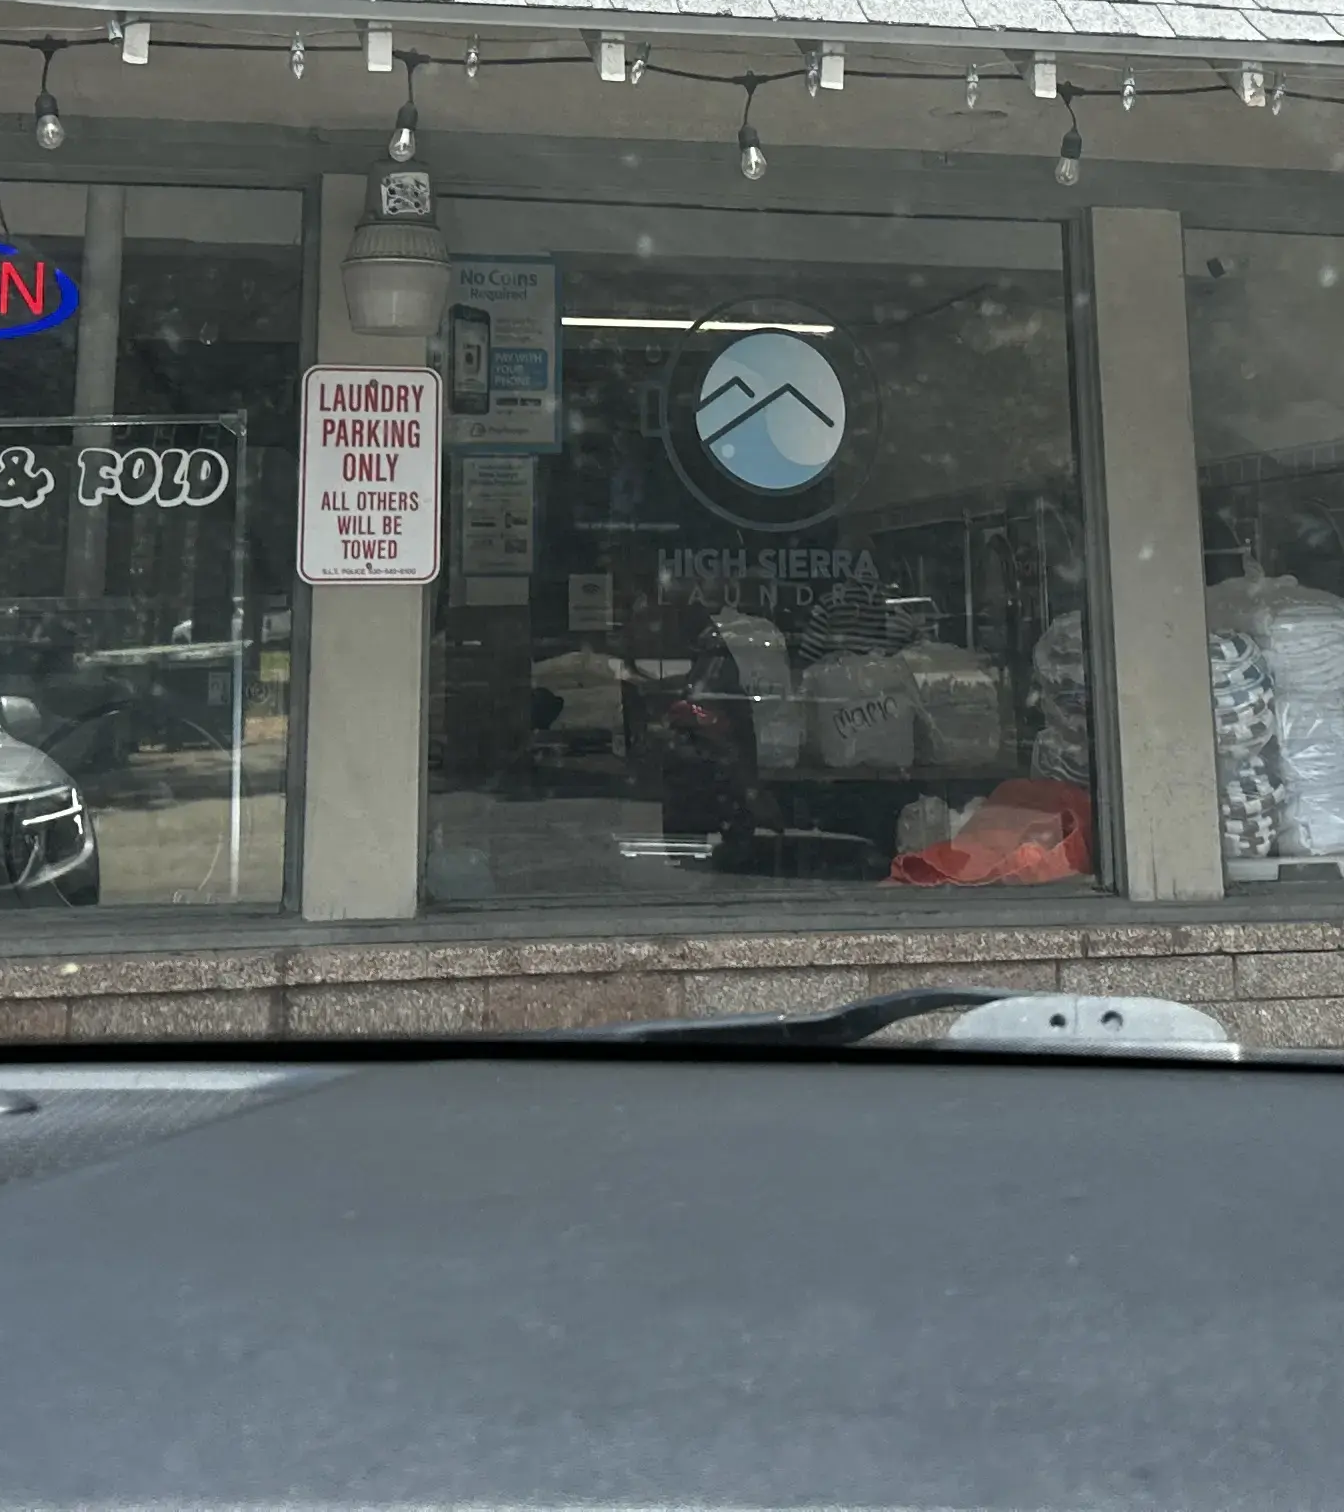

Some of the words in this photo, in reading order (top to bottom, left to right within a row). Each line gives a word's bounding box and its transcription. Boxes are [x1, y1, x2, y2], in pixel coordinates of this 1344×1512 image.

[460, 268, 485, 286] No
[488, 268, 538, 287] Coins
[319, 383, 425, 414] LAUNDRY
[321, 419, 421, 449] PARKING
[78, 446, 230, 508] FOLD
[342, 453, 400, 483] ONLY
[321, 492, 351, 512] ALL
[357, 491, 419, 512] OTHERS
[337, 515, 376, 536] WILL
[382, 515, 402, 536] BE
[341, 539, 398, 561] TOWED
[658, 549, 746, 580] HIGH
[757, 549, 880, 580] SIERRA
[658, 586, 881, 608] LAUNDRY
